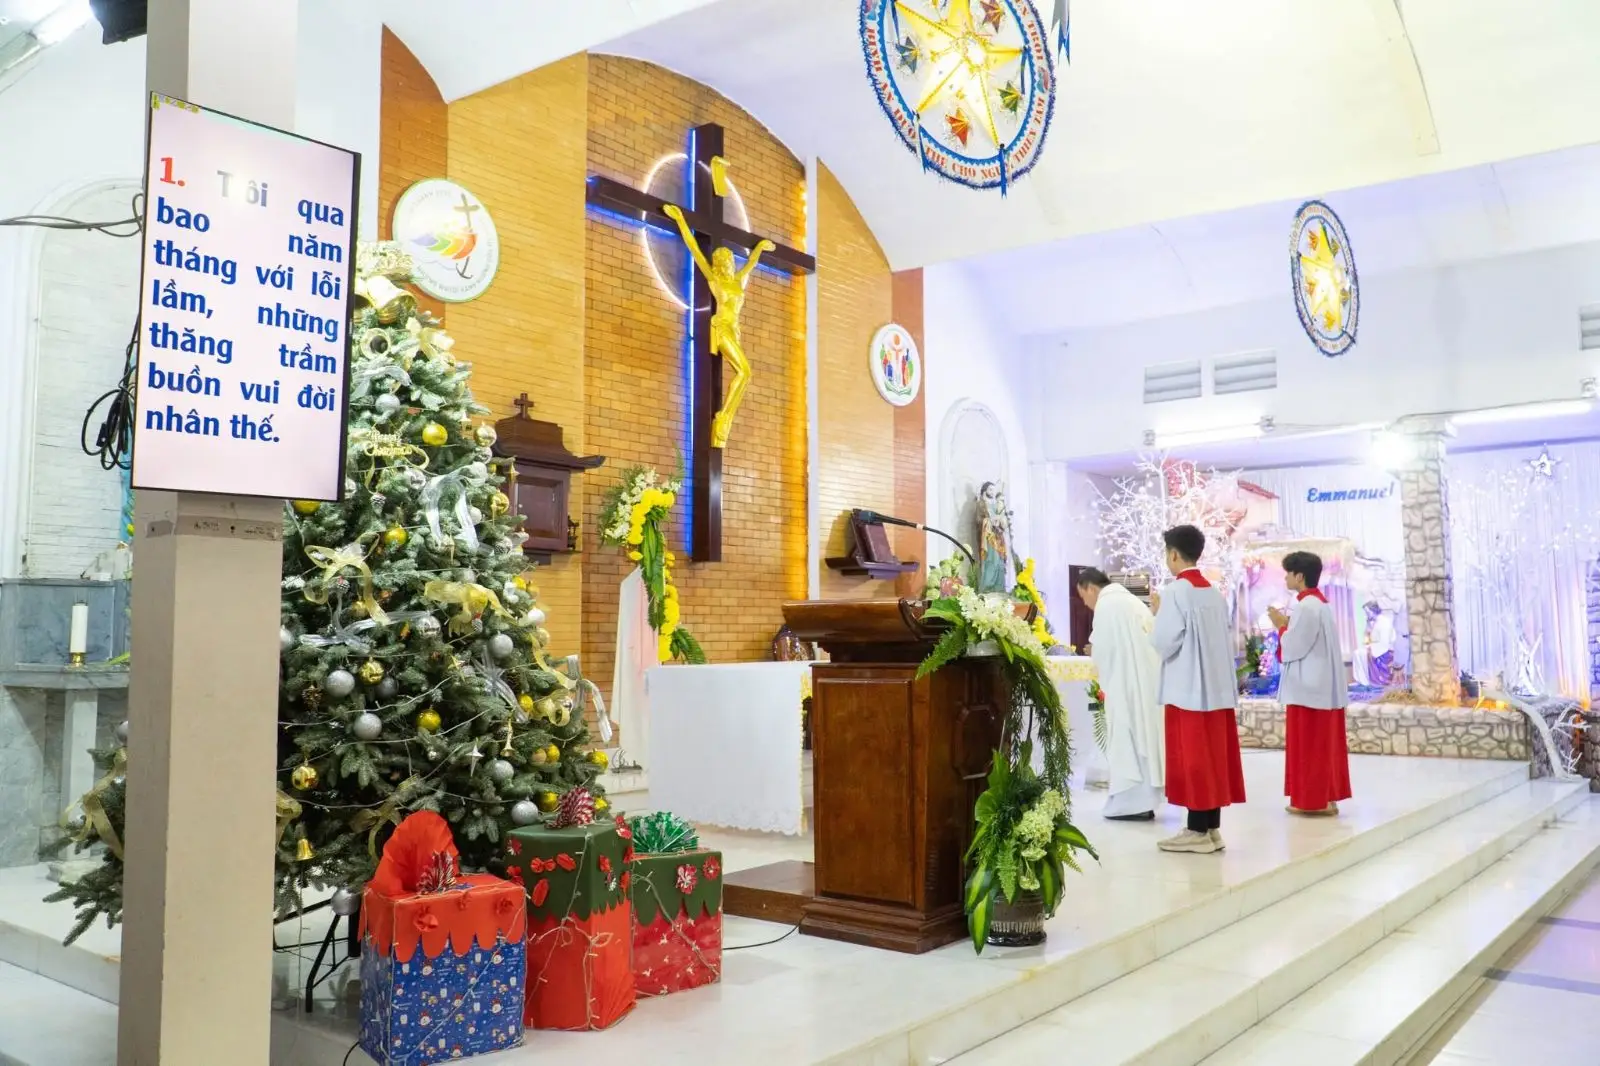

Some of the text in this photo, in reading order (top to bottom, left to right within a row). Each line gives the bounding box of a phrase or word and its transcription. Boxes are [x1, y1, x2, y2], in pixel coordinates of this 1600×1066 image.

[159, 157, 185, 187] 1.
[297, 199, 344, 227] qua
[156, 196, 344, 264] bao năm
[153, 240, 341, 301] tháng với lỗi
[152, 278, 340, 343] lầm, những
[149, 322, 338, 375] thăng trầm
[148, 362, 336, 412] buồn vui đời
[146, 405, 280, 443] nhân thế.
[1307, 481, 1395, 503] Emmanuel
